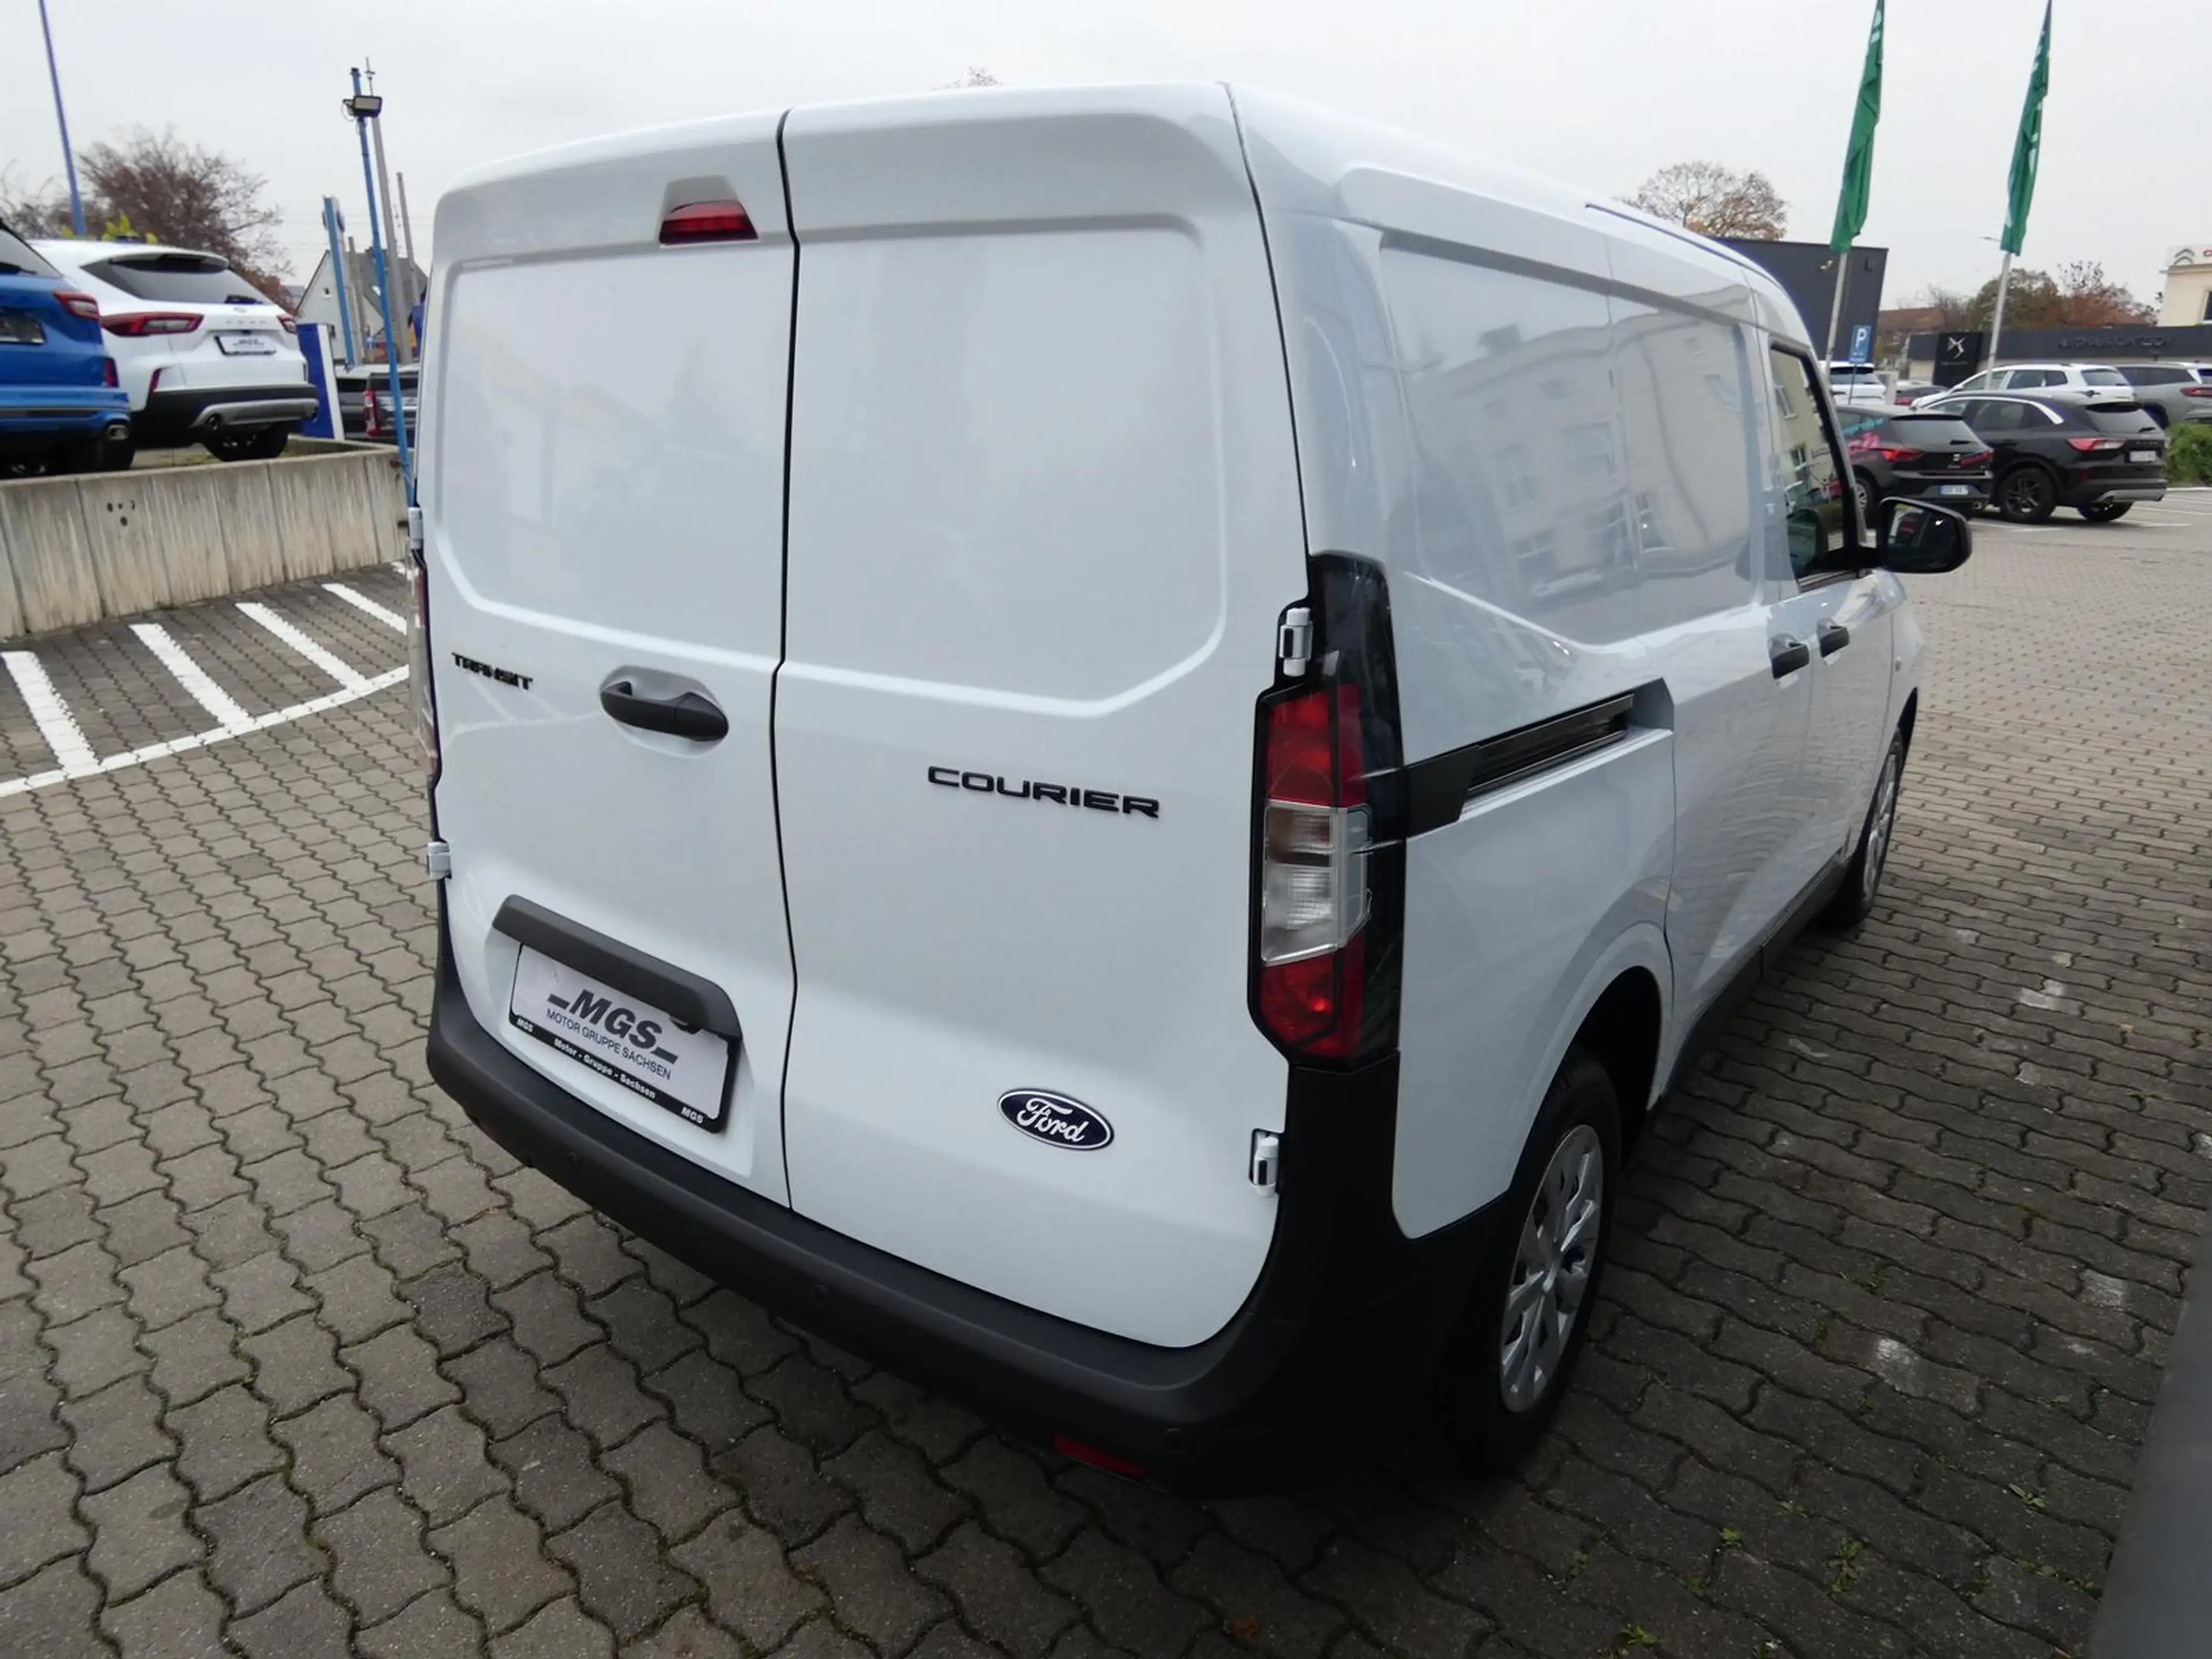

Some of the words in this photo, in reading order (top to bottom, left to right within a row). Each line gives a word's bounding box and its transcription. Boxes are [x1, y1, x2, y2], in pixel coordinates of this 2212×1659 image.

[1855, 328, 1868, 348] P
[927, 766, 1160, 819] COURIER
[516, 1017, 534, 1033] MGS
[569, 989, 662, 1050] MGS
[547, 1009, 581, 1034] MOTOR
[581, 1027, 620, 1055] GRUPPE
[622, 1046, 672, 1081] SACHSEN
[554, 1037, 577, 1056] Motor
[583, 1054, 613, 1076] Gruppe
[620, 1073, 656, 1100] Sachsen
[680, 1106, 704, 1124] MGS
[1017, 1097, 1089, 1142] Ford
